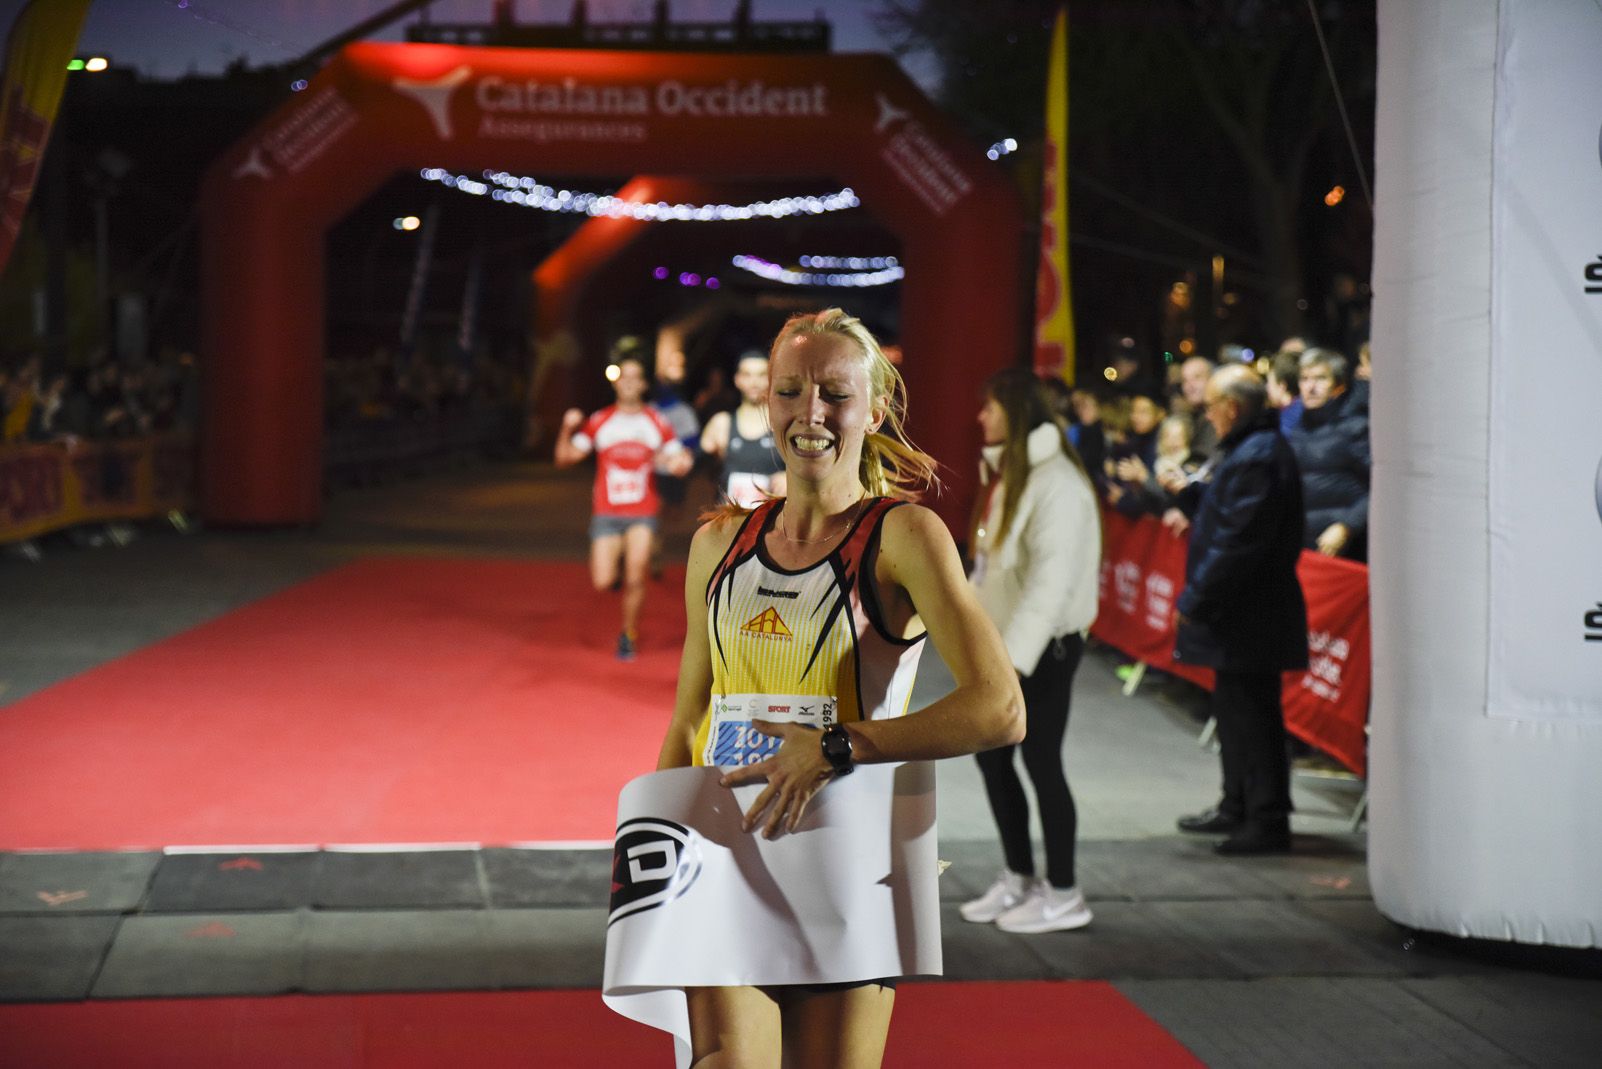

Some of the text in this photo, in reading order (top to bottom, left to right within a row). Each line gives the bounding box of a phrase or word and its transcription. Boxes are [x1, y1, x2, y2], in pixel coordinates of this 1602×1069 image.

[477, 75, 826, 116] Catalana Occident
[768, 705, 791, 713] SPORT
